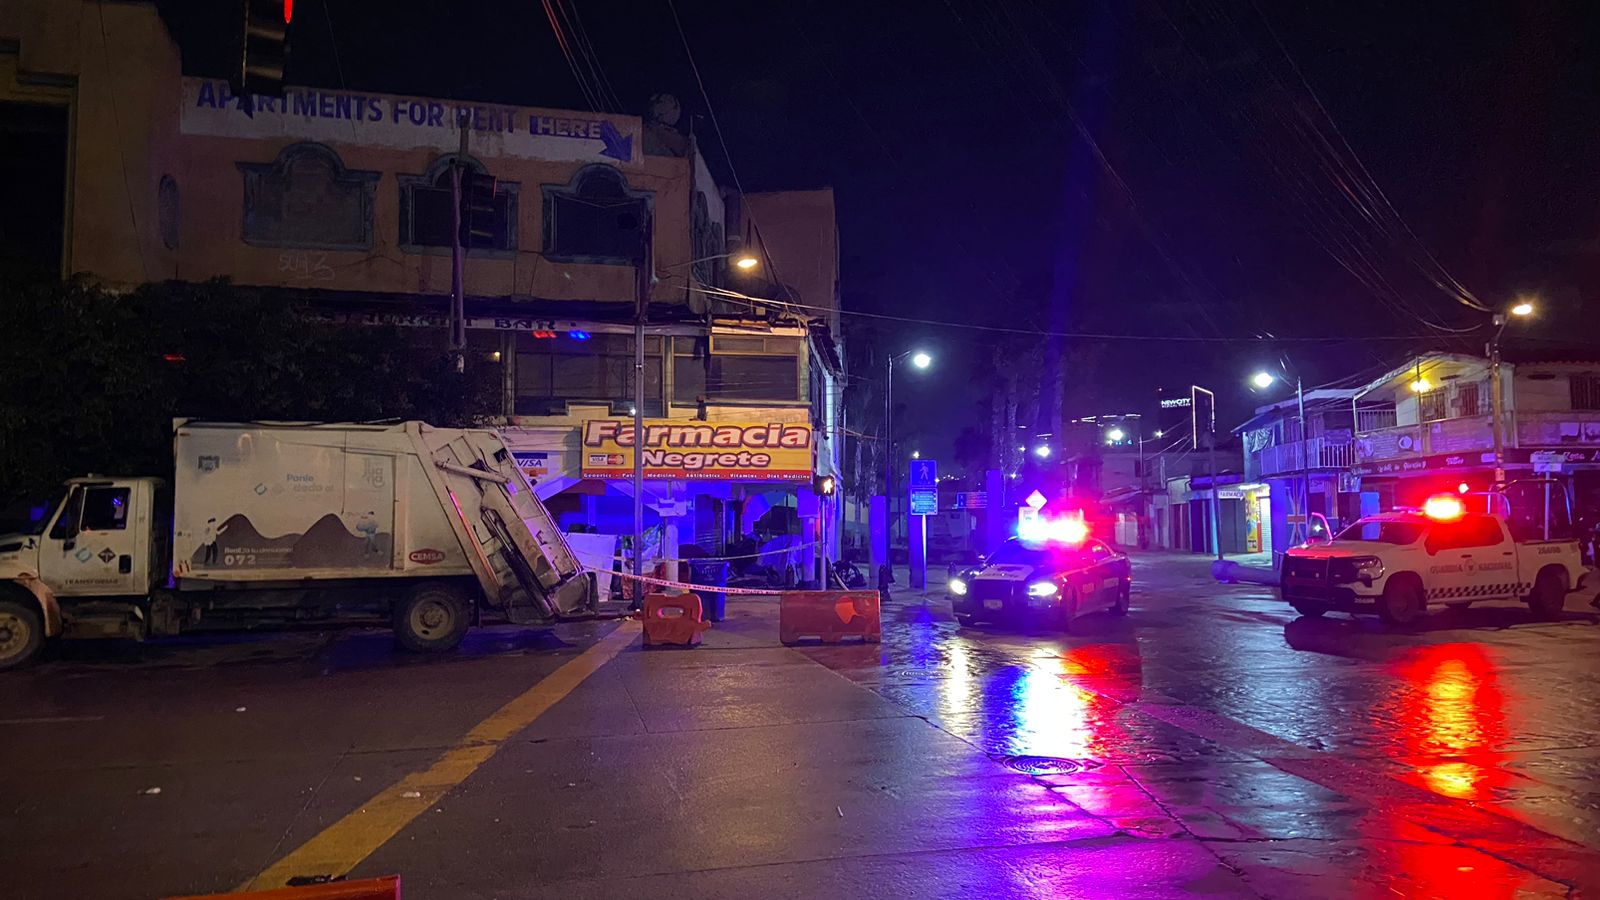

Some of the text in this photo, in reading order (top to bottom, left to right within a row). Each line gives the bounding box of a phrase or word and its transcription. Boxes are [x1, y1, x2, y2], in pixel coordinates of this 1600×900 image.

[393, 98, 444, 127] FOR
[456, 105, 518, 133] RENT
[535, 116, 602, 139] HERE
[494, 318, 555, 330] BAR
[584, 420, 810, 447] Farmacia
[516, 459, 542, 467] VISA
[641, 448, 771, 470] Negrete
[224, 554, 256, 566] 072
[410, 552, 443, 561] CEMSA
